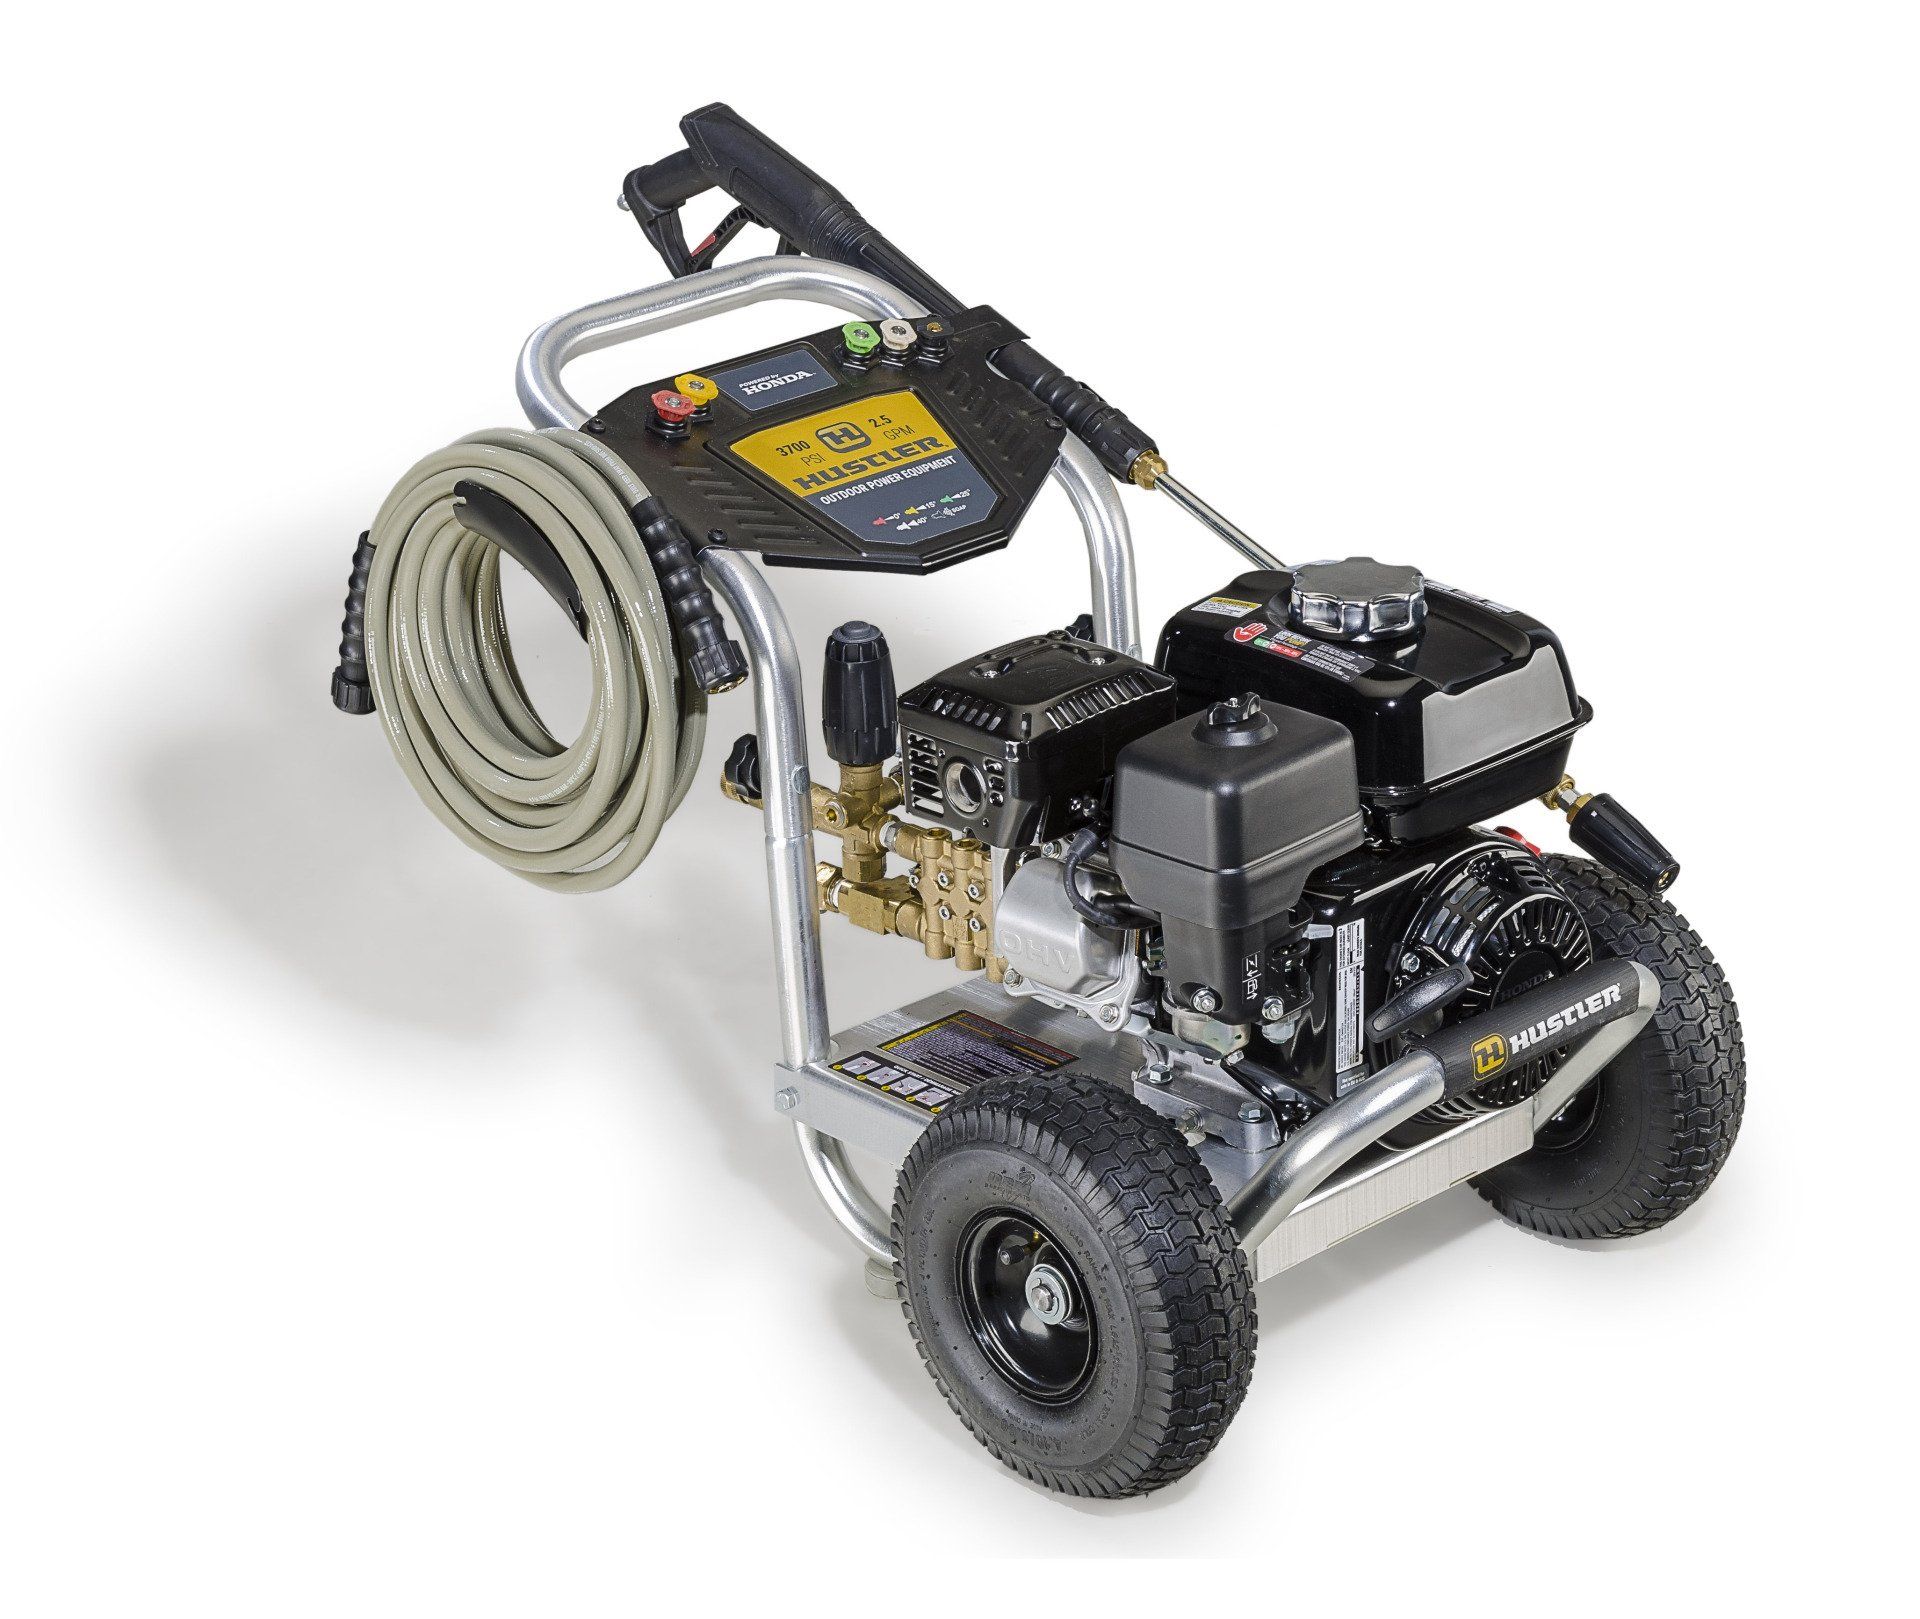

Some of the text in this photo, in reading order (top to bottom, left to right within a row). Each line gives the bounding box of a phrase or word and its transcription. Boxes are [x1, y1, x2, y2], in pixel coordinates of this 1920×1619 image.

[738, 374, 771, 388] POWERED
[742, 370, 814, 396] HONDA
[868, 414, 893, 428] 2.5
[883, 424, 916, 441] GPM
[775, 440, 811, 457] 3700
[800, 452, 826, 467] PSI
[793, 436, 945, 491] HUSTLER
[820, 455, 958, 505] OUTDOOR POWER EQUIPMENT
[1000, 929, 1072, 974] OHV
[1501, 970, 1555, 1001] HONDA
[1509, 984, 1622, 1055] HUSTLER
